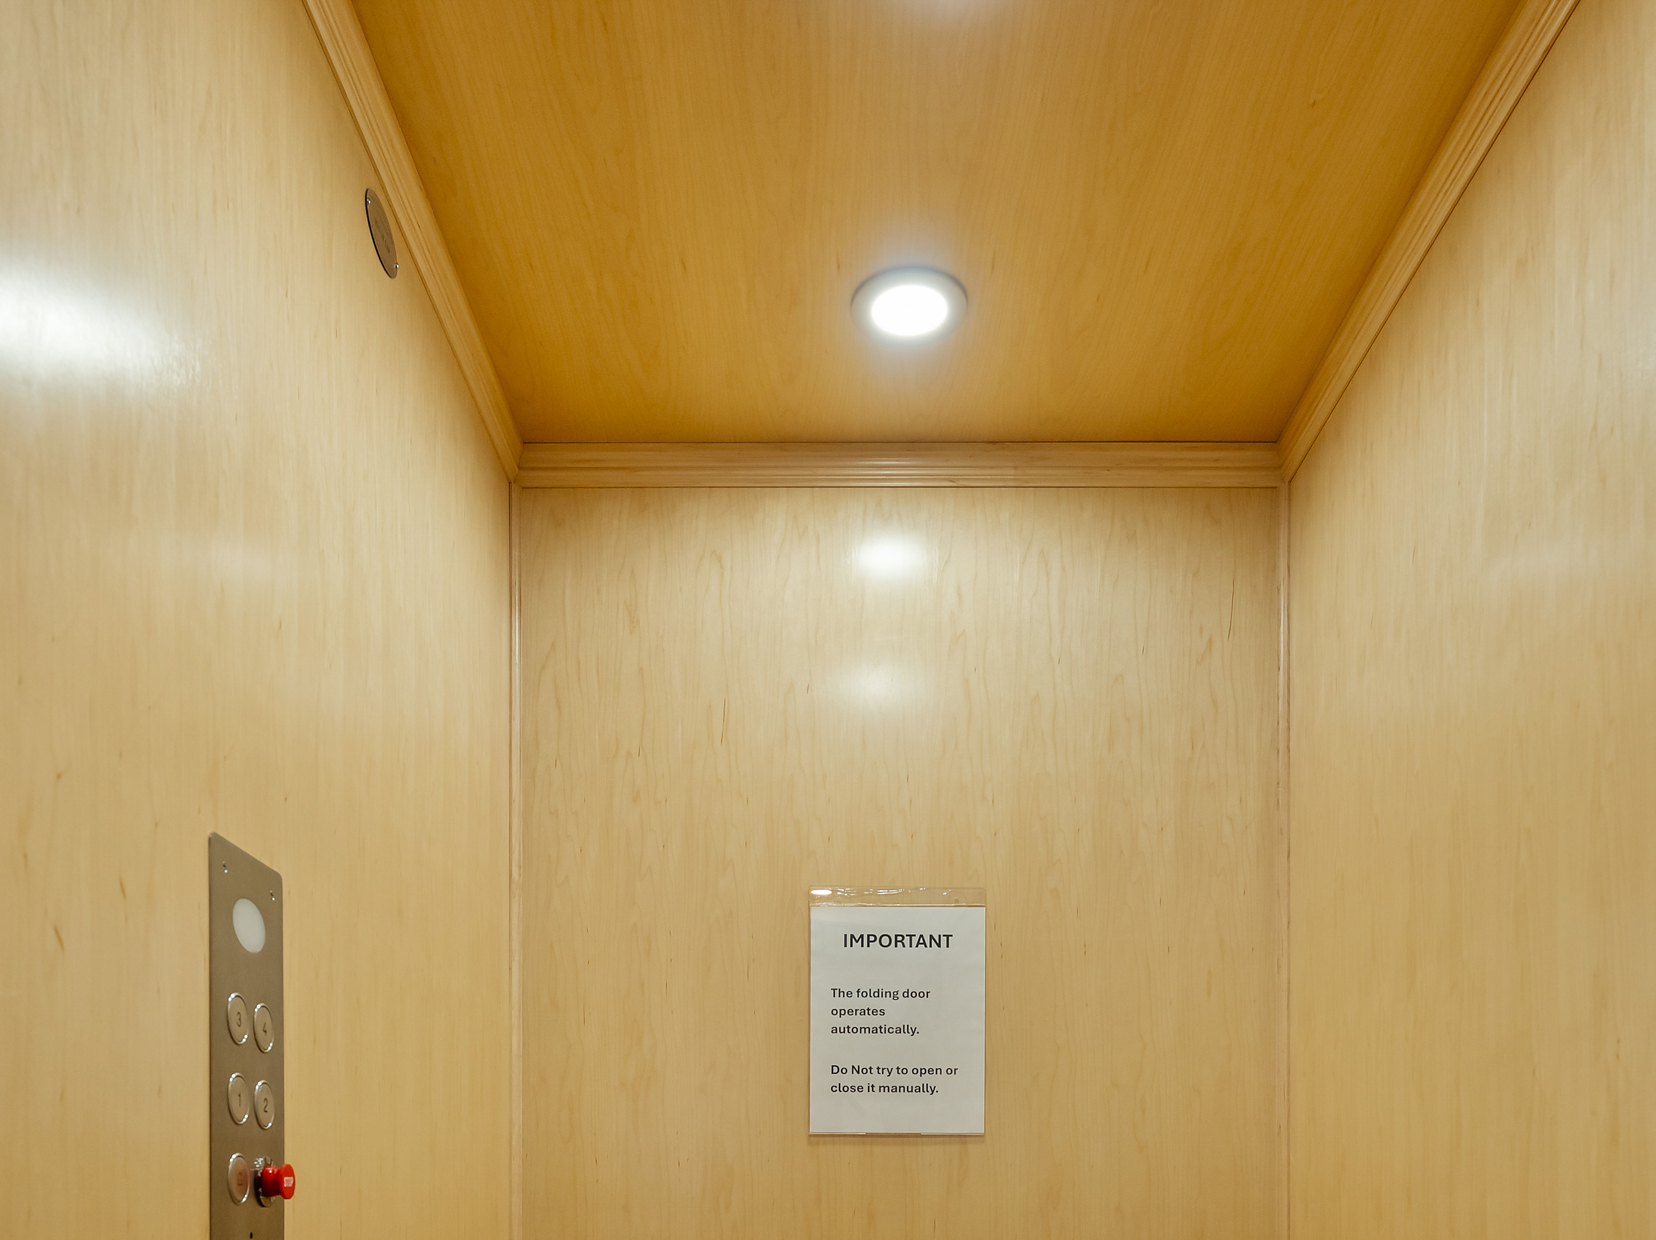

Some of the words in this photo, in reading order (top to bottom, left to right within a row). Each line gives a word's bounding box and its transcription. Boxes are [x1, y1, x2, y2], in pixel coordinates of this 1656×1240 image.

[843, 933, 954, 949] IMPORTANT
[830, 987, 853, 999] The
[856, 988, 900, 1001] folding
[902, 988, 931, 999] door
[830, 1006, 886, 1019] operates
[236, 1011, 242, 1028] 3
[262, 1022, 268, 1037] 4
[830, 1024, 920, 1037] automatically.
[830, 1064, 848, 1075] Do
[851, 1064, 874, 1075] Not
[876, 1065, 893, 1078] try
[896, 1065, 909, 1076] to
[911, 1067, 943, 1078] open
[945, 1068, 959, 1076] or
[830, 1082, 864, 1093] close
[867, 1082, 876, 1093] it
[878, 1082, 939, 1096] manually.
[237, 1093, 242, 1108] 1
[263, 1098, 269, 1113] 2
[283, 1176, 294, 1188] STOP
